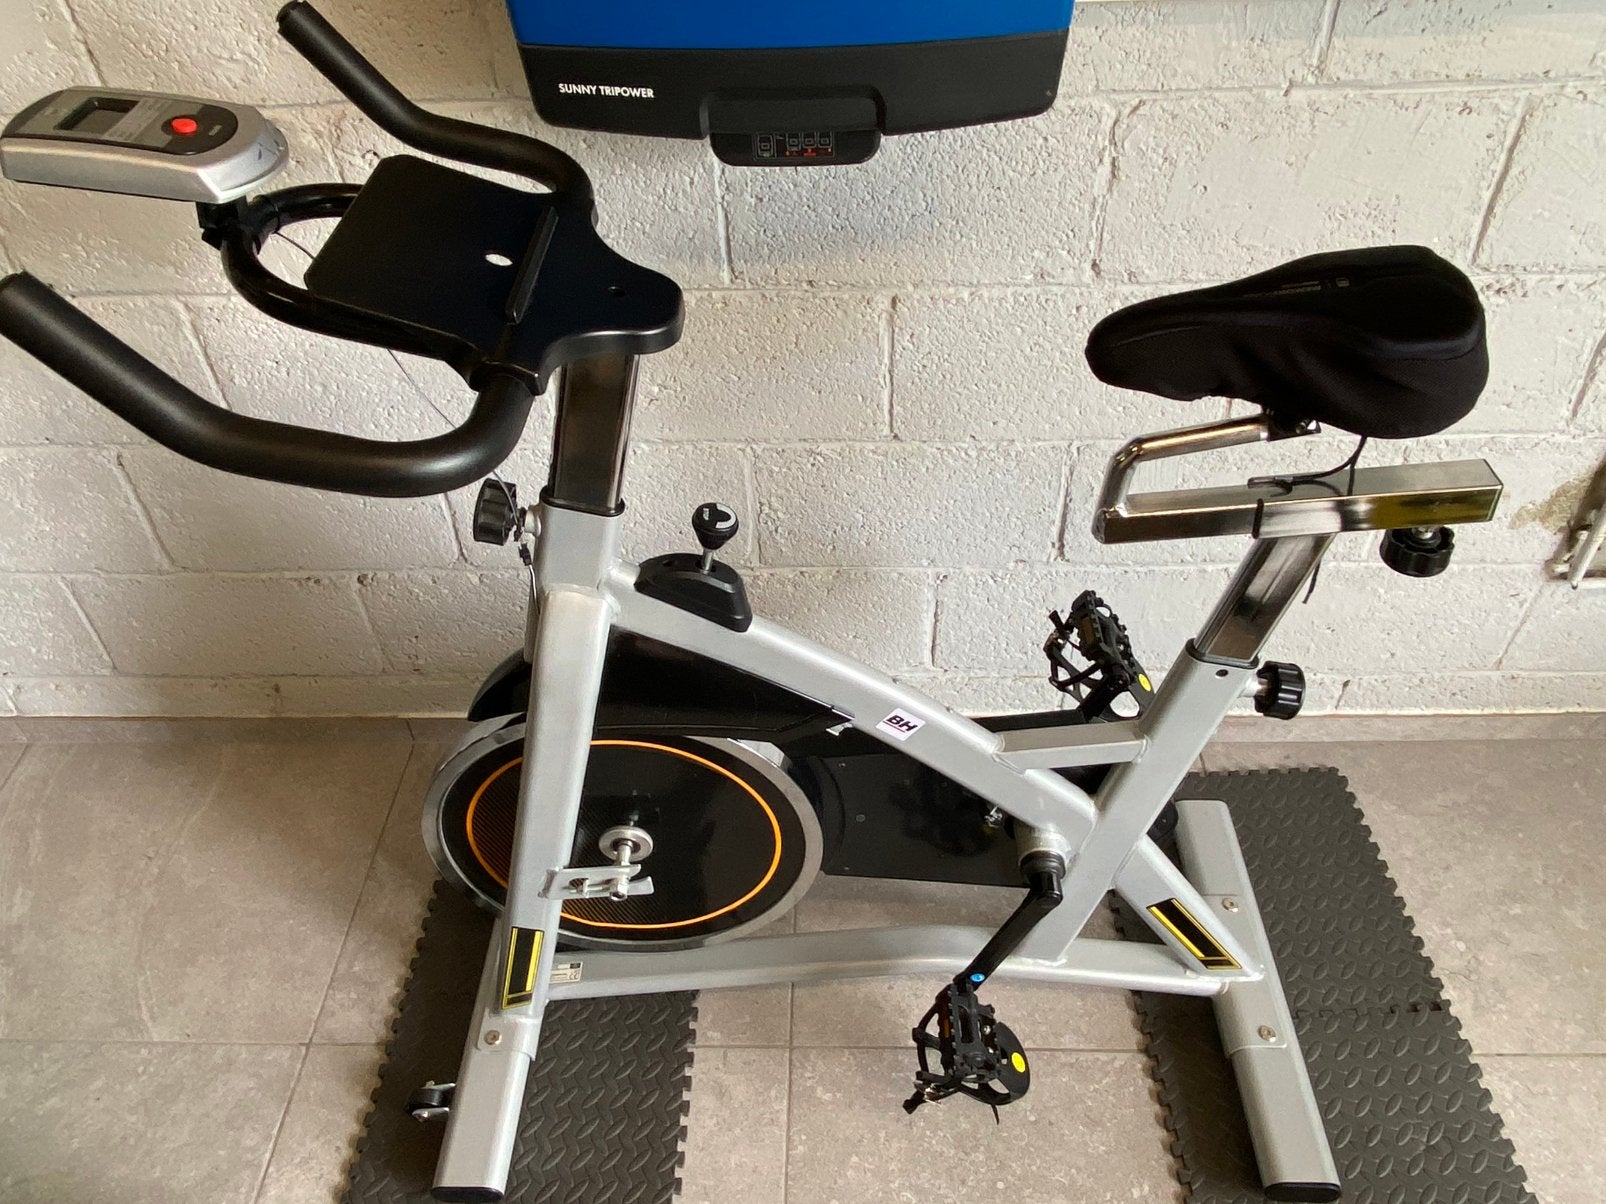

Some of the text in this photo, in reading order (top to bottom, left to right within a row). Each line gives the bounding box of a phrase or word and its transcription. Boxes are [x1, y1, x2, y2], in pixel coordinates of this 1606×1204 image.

[558, 83, 655, 98] SUNNY TRIPOWER
[886, 714, 918, 732] BH
